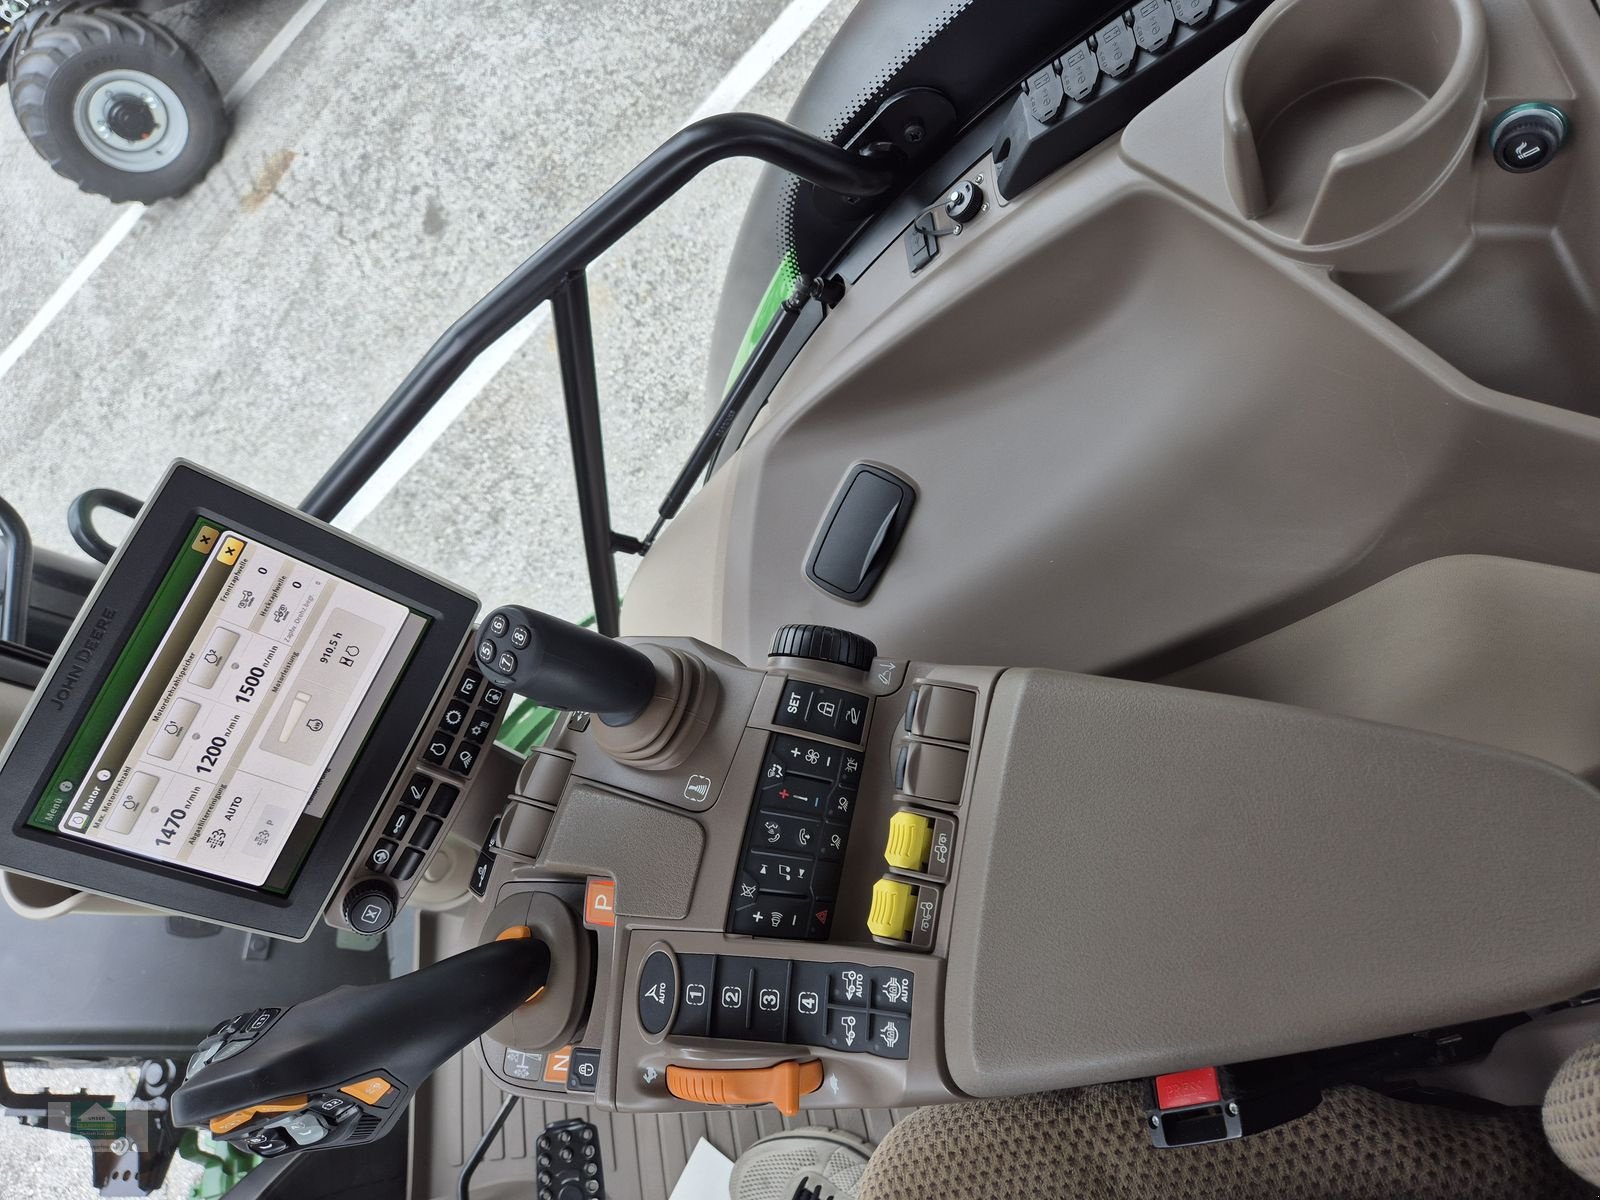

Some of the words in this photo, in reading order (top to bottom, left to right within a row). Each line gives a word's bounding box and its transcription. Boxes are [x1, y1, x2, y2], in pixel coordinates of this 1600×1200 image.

[220, 557, 248, 602] Frontzapfwelle
[257, 565, 268, 575] 0
[259, 574, 286, 617] Heckzapfwelle
[291, 579, 303, 589] 0
[51, 664, 85, 711] JOHN
[74, 607, 116, 663] DEERE
[319, 638, 339, 664] 910,5
[234, 665, 266, 705] 1500
[261, 644, 279, 668] n/min
[271, 650, 299, 693] Motorleistung
[152, 651, 196, 721] Motordrehzahlspeicher
[787, 692, 801, 714] SET
[194, 734, 227, 775] 1200
[223, 713, 241, 737] n/min
[43, 797, 63, 821] Menü
[81, 786, 101, 811] Motor
[92, 812, 107, 828] Max.
[101, 766, 132, 812] Motordrehzahl
[223, 795, 243, 821] AUTO
[154, 806, 187, 848] 1470
[183, 785, 201, 809] n/min
[594, 894, 613, 910] P
[658, 982, 667, 1004] AUTO
[725, 992, 738, 1003] 2
[855, 973, 864, 998] AUTO
[901, 978, 909, 1003] AUTO
[763, 994, 776, 1005] 3
[801, 997, 816, 1009] 4
[553, 1054, 570, 1071] N
